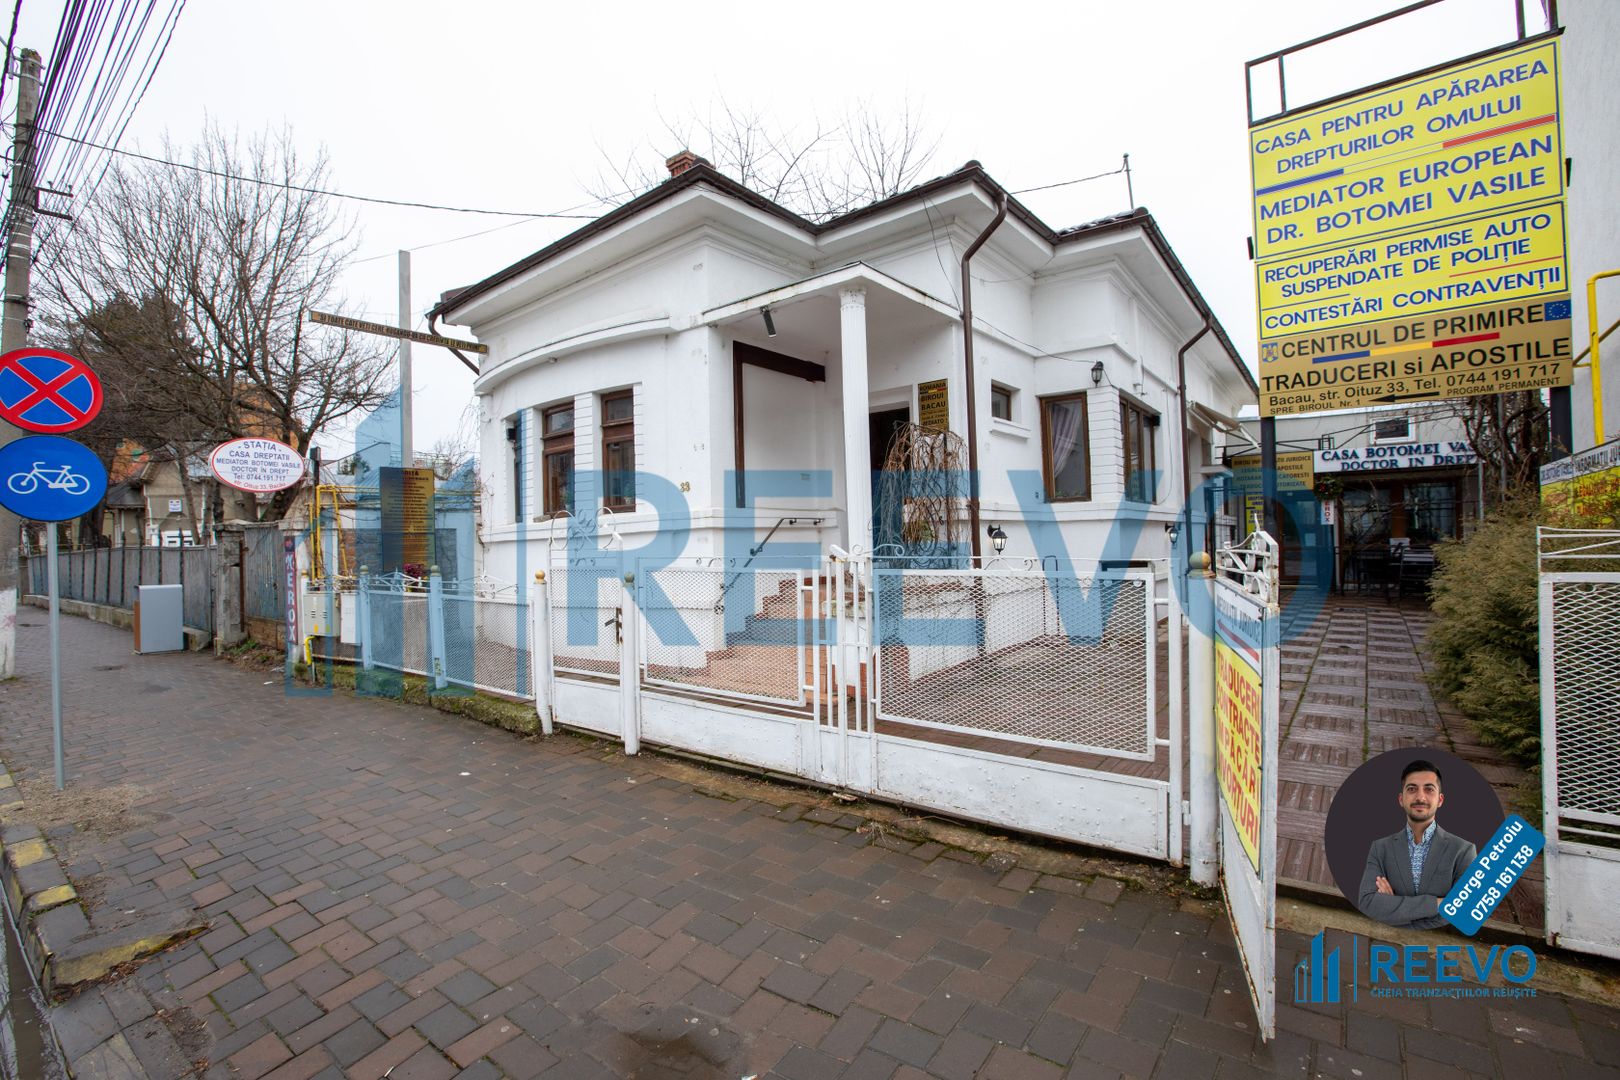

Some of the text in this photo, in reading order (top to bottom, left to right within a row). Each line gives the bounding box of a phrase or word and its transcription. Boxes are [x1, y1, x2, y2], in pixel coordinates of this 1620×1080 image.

[1255, 60, 1549, 154] CASA PENTRU APĂRAREA
[1277, 95, 1521, 174] DREPTURILOR OMULUI
[1260, 135, 1552, 220] MEDIATOR EUROPEAN
[1267, 167, 1545, 244] DR. BOTOMEI VASILE
[1265, 214, 1551, 283] RECUPERĂRI PERMISE AUTO
[1282, 238, 1531, 298] SUSPENDATE DE POLIȚIE
[1265, 266, 1560, 330] CONTESTĂRI CONTRAVENȚII
[1282, 304, 1543, 358] CENTRUL DE PRIMIRE
[1262, 337, 1570, 392] TRADUCERI si APOSTILE
[1269, 363, 1560, 407] Bacau, str. Oituz 33, Tel. 0744 191 717
[1447, 377, 1560, 397] PROGRAM PERMANENT
[1270, 406, 1294, 416] SPRE
[1299, 403, 1335, 413] BIROUL
[229, 450, 250, 458] CASA
[251, 459, 279, 467] BOTOMEI
[281, 461, 301, 469] VASILE
[269, 467, 289, 475] DREPT
[1321, 451, 1359, 461] CASA
[1366, 443, 1439, 458] BOTOMEI
[1341, 459, 1398, 471] DOCTOR
[1409, 457, 1424, 467] IN
[285, 554, 297, 642] XEROX
